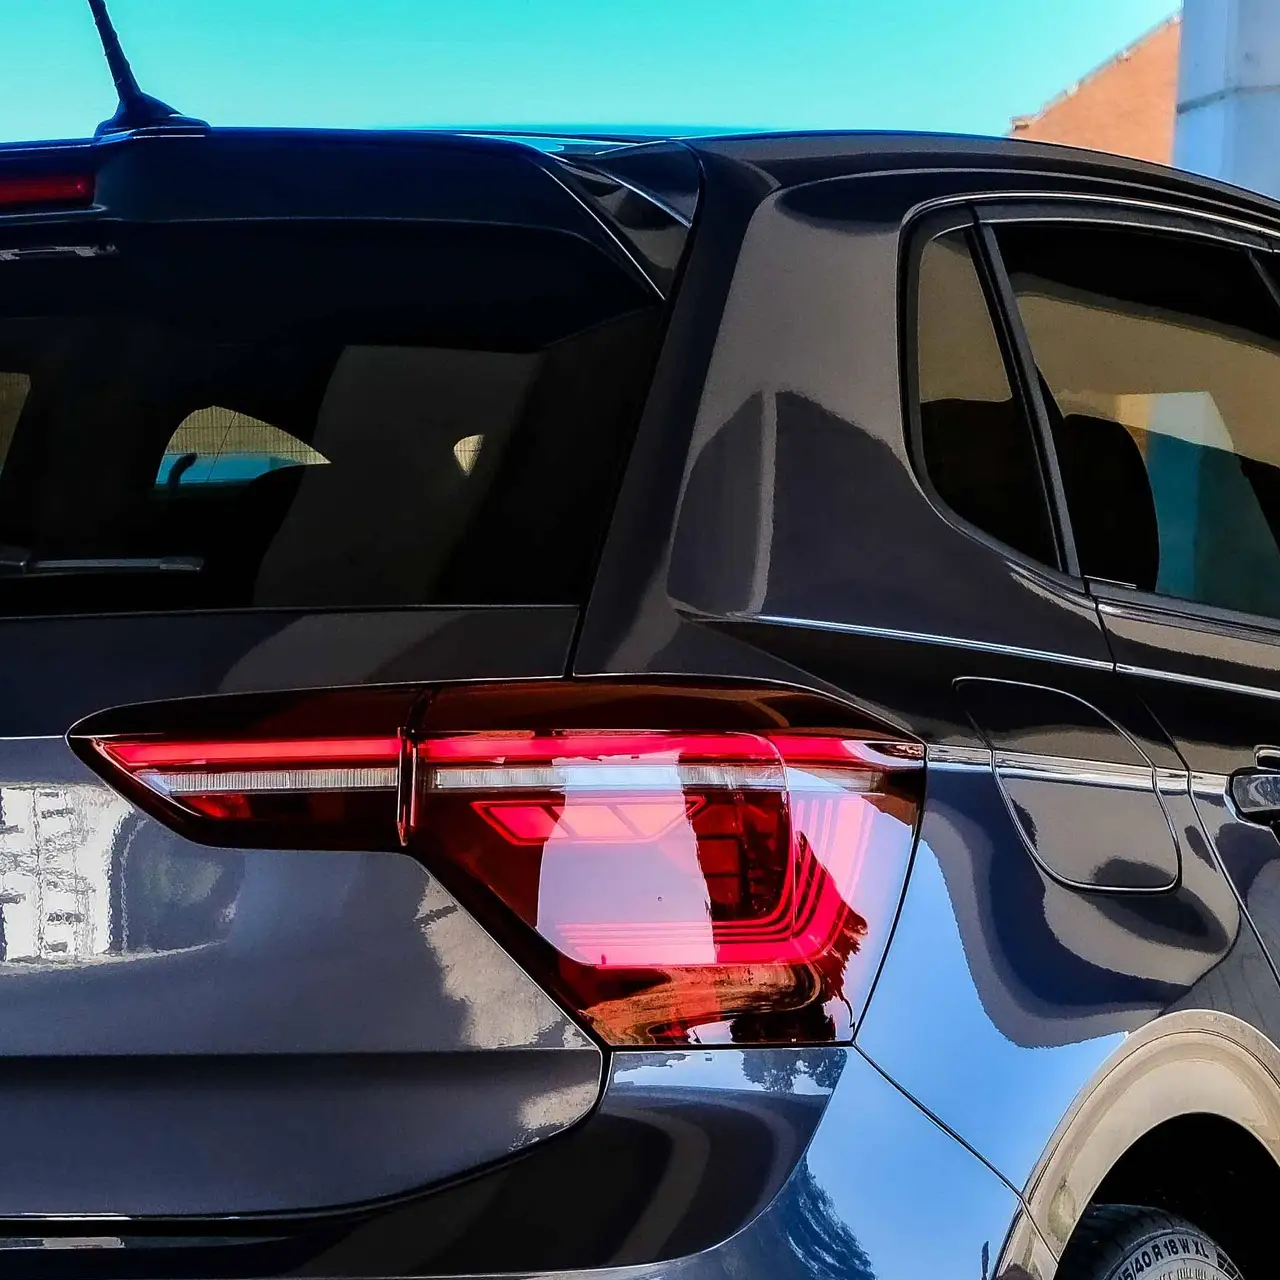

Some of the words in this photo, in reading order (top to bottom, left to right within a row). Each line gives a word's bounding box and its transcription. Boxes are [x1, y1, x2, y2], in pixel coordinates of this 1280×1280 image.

[1151, 1244, 1164, 1262] R
[1178, 1237, 1191, 1254] W
[1191, 1239, 1210, 1260] XL
